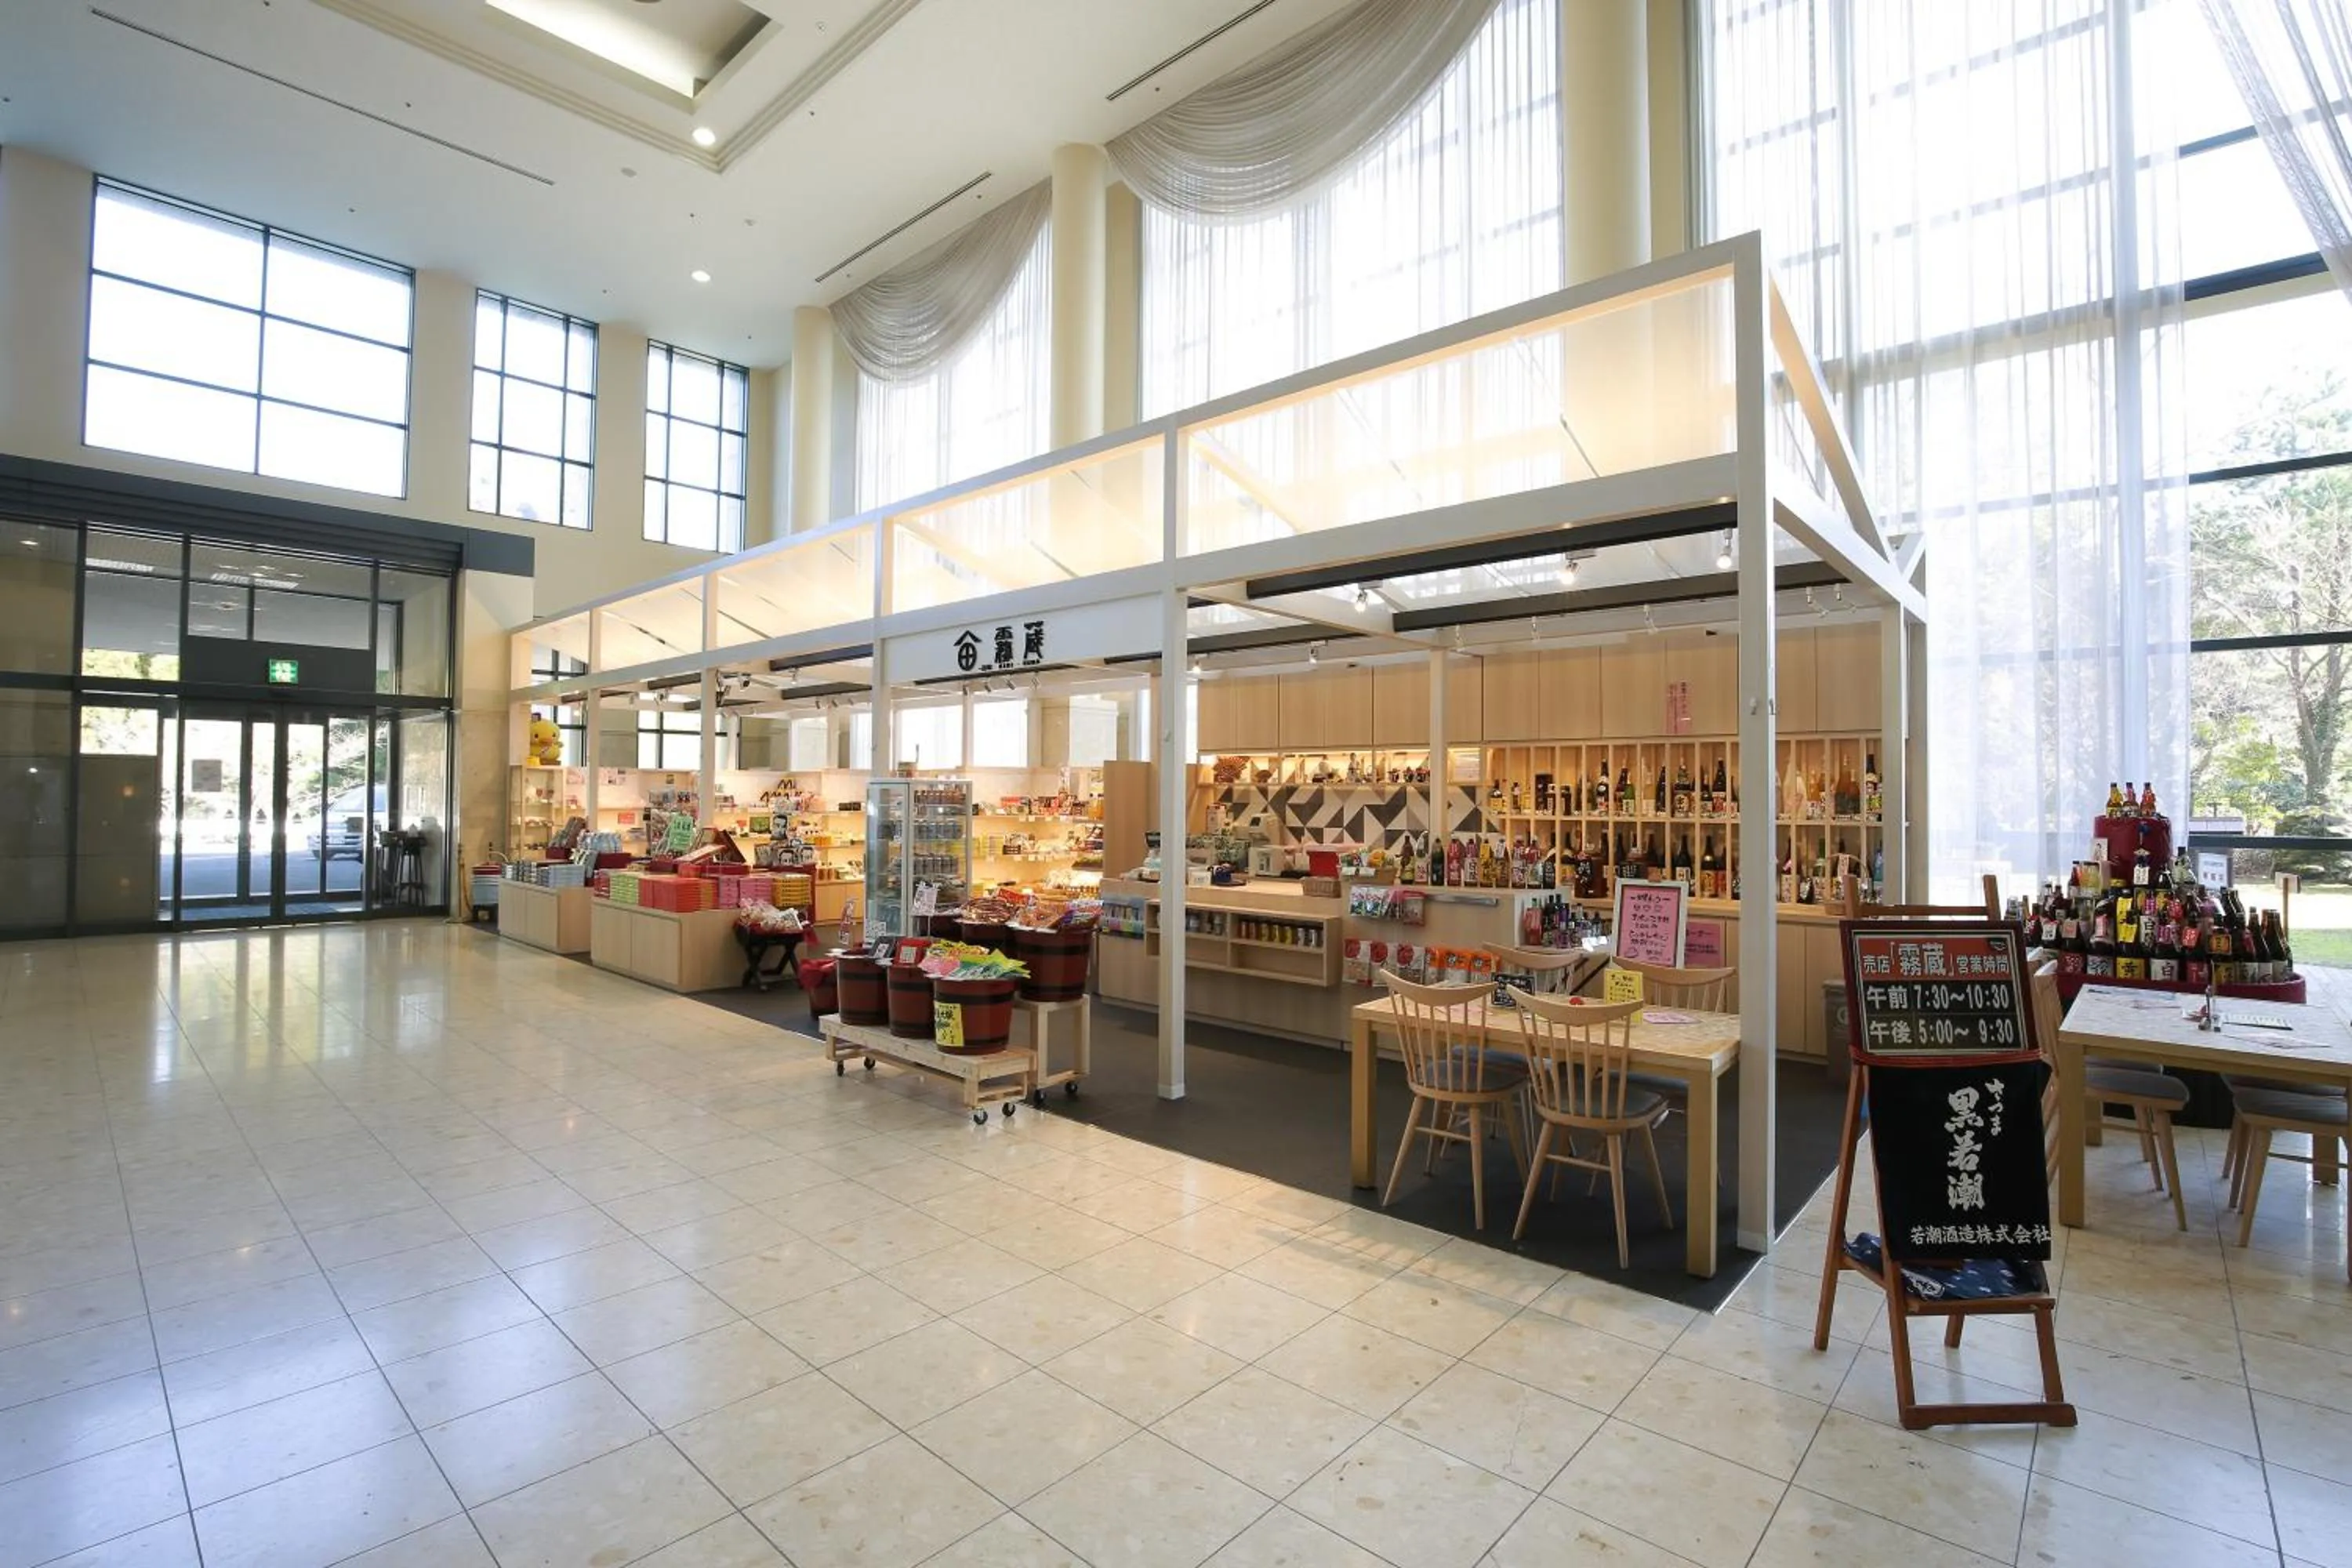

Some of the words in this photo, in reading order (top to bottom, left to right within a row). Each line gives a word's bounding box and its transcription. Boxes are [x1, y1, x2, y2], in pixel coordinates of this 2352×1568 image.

[1867, 984, 1908, 1010] 午前
[1869, 1019, 1913, 1044] 午後
[1984, 1078, 2005, 1136] さつま
[1910, 1225, 2052, 1244] 若潮酒造株式会社
